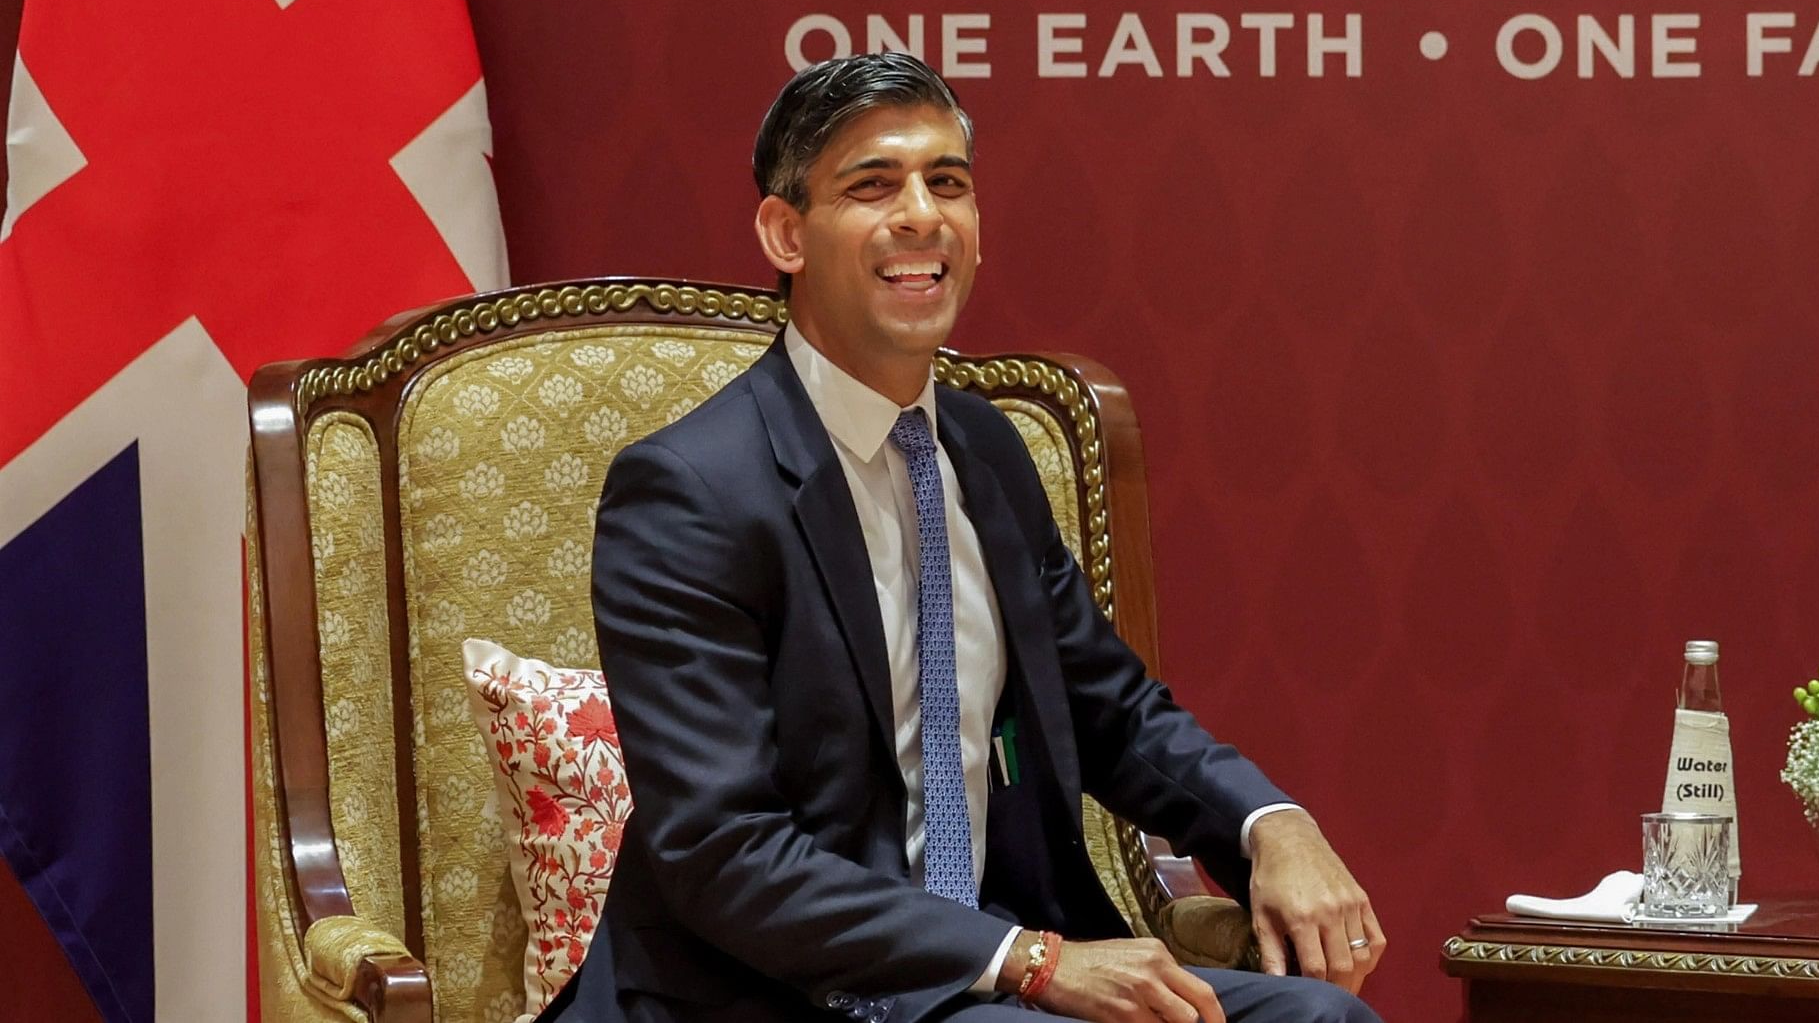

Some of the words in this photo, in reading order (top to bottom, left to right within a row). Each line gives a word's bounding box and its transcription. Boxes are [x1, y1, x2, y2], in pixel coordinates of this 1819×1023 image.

[784, 13, 991, 78] ONE
[1038, 13, 1362, 77] EARTH
[1496, 13, 1701, 79] ONE
[1677, 758, 1727, 772] Water
[1677, 784, 1724, 802] (Still)
